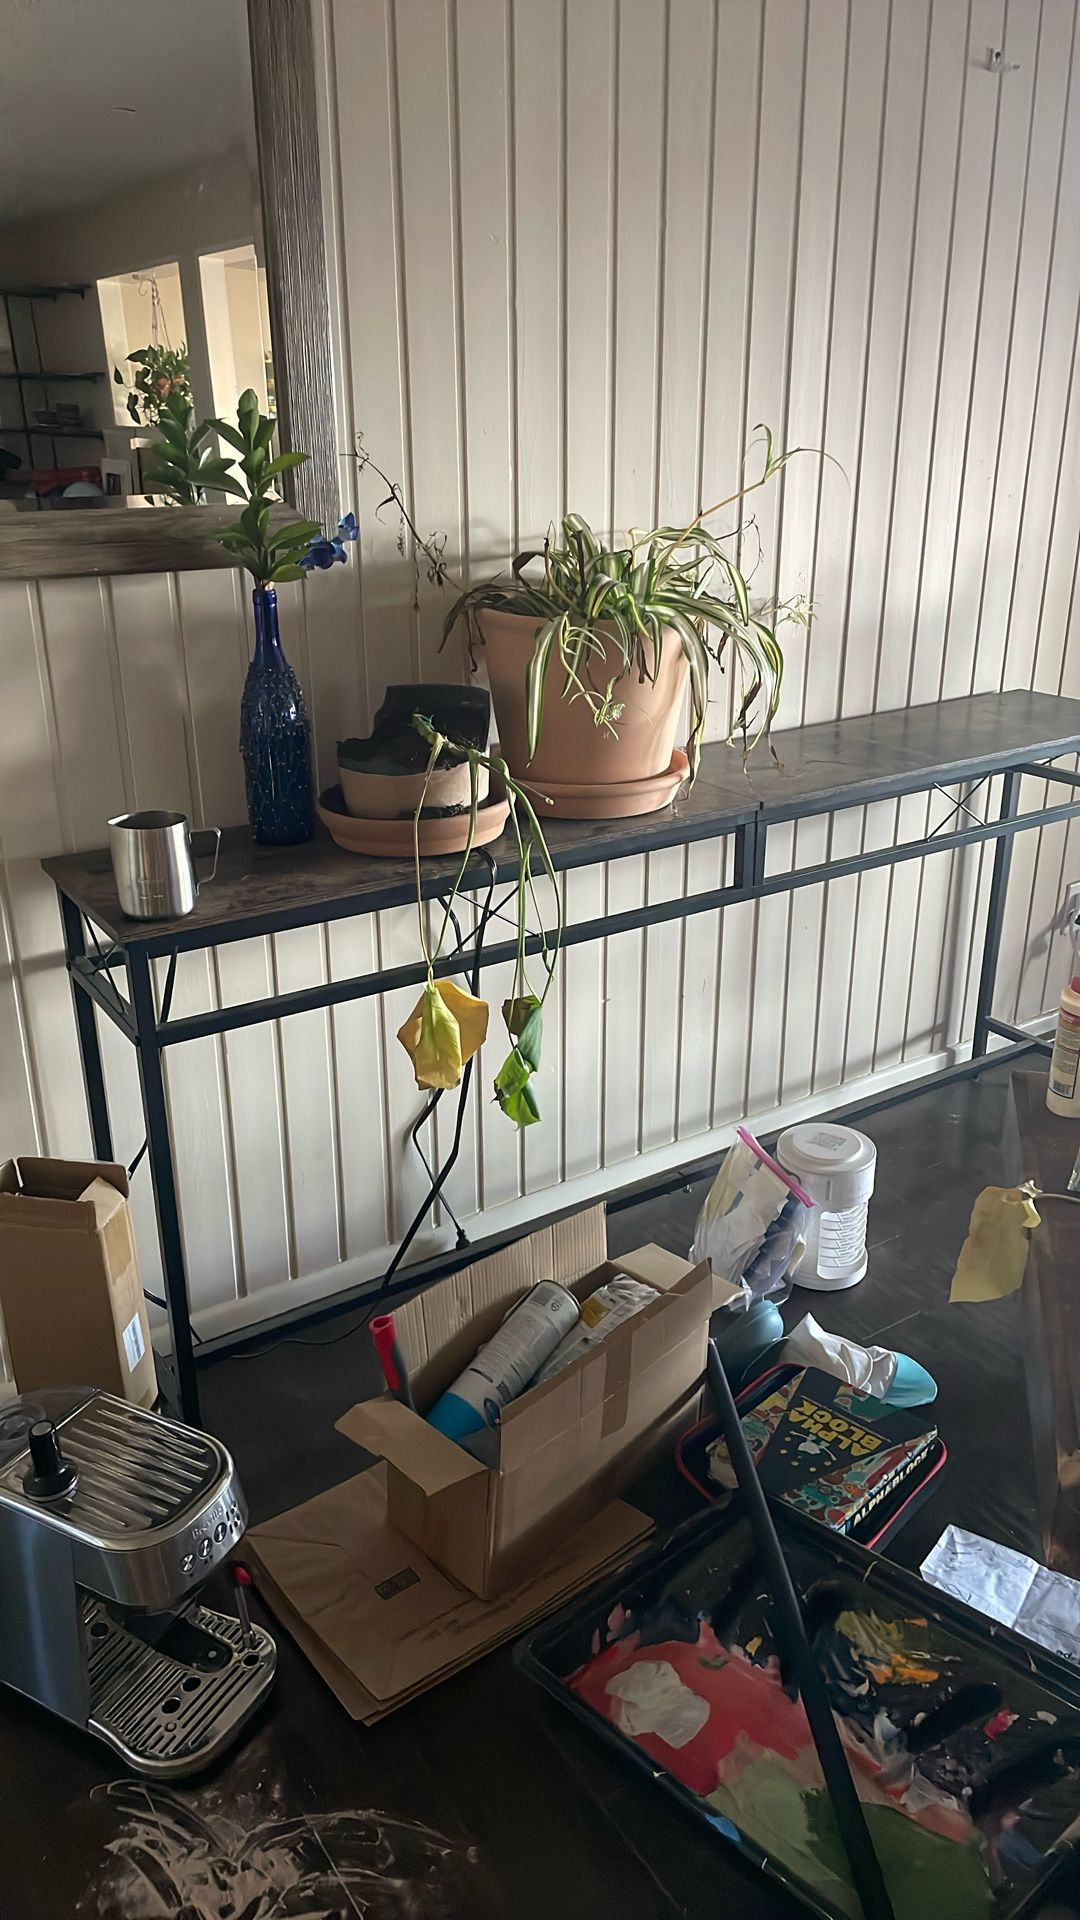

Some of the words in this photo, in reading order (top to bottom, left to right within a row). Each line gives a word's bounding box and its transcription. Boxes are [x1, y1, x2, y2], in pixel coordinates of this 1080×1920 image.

[788, 1408, 871, 1457] ALPHA
[791, 1399, 883, 1451] BLOCK
[853, 1448, 929, 1527] ALPHABLOCK
